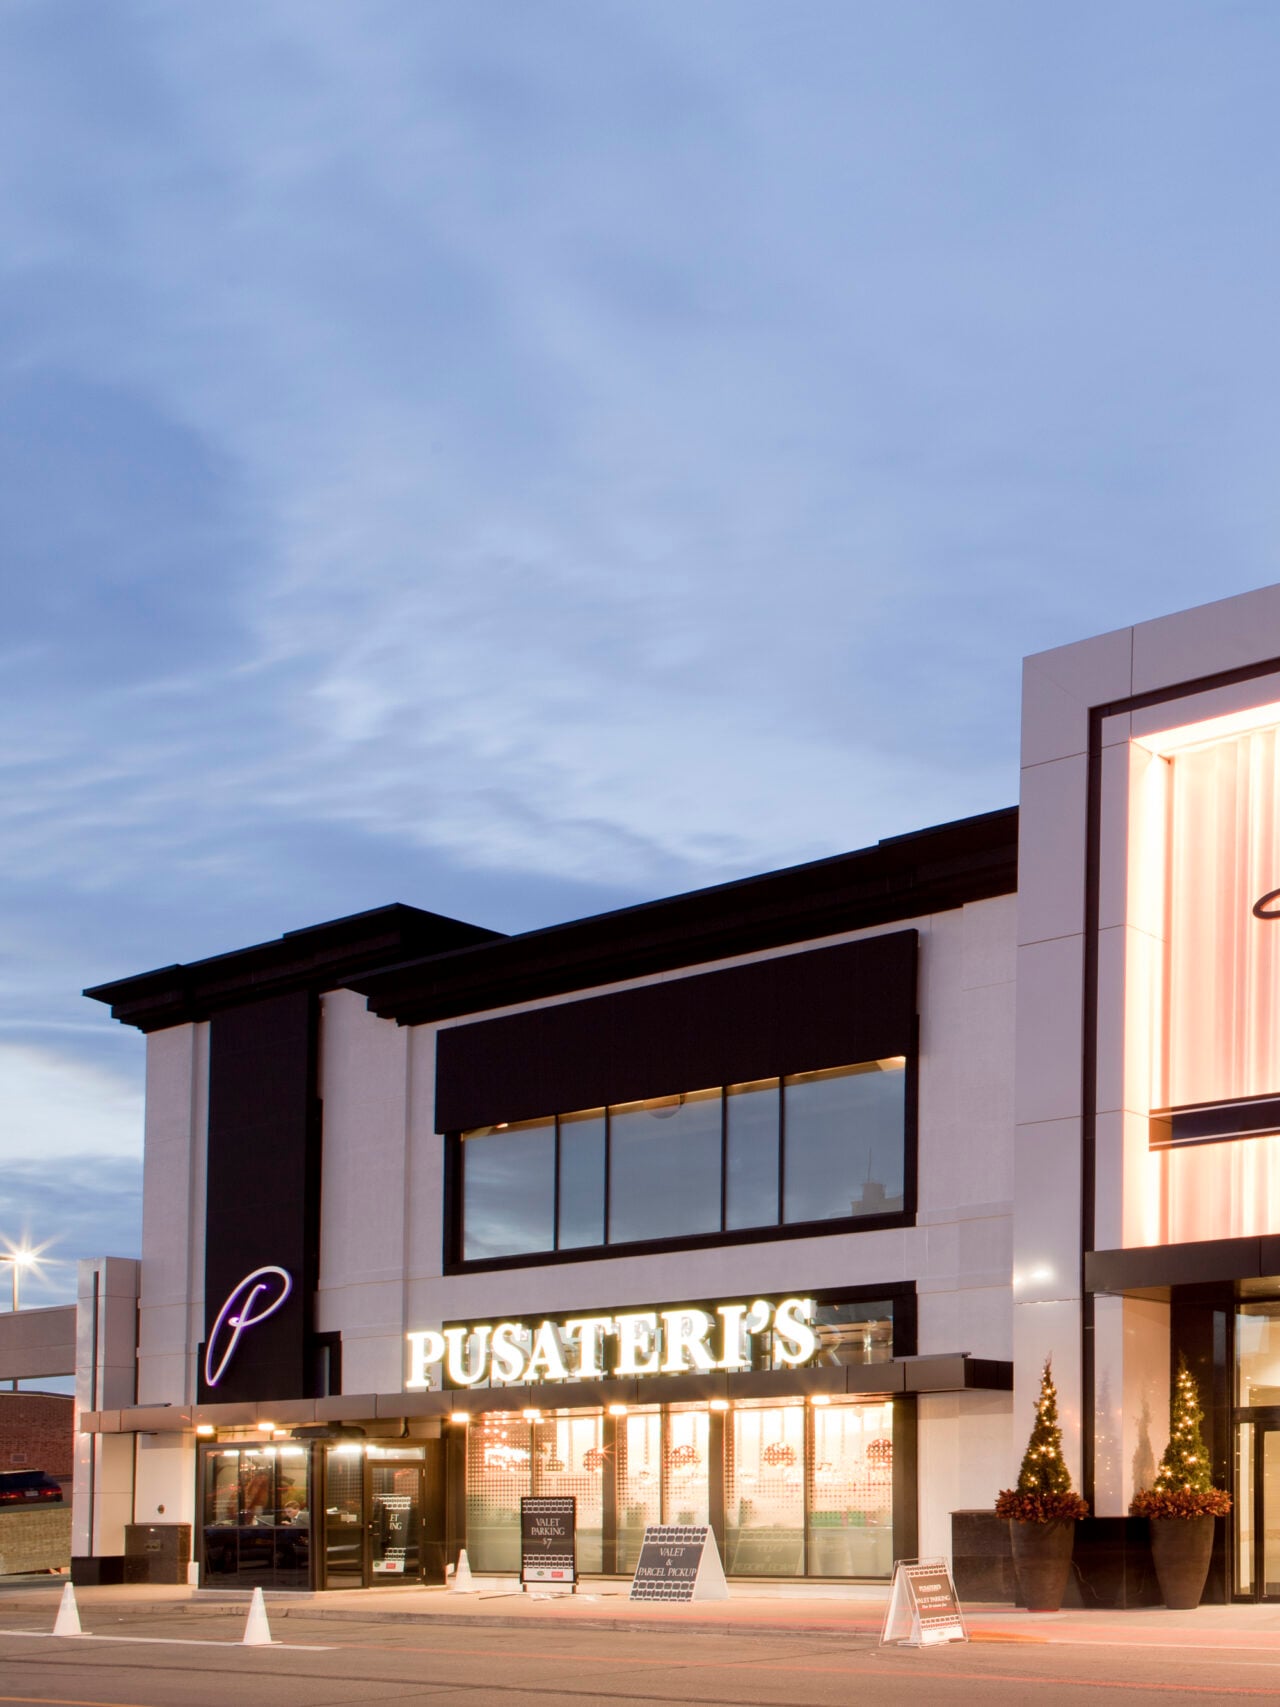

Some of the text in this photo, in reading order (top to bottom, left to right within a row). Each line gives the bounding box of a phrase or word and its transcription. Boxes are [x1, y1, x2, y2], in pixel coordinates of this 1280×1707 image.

[405, 1297, 821, 1389] PUSATERI'S
[535, 1518, 561, 1527] VALET
[531, 1527, 565, 1536] PARKING
[542, 1537, 552, 1549] $7
[659, 1547, 685, 1557] VALET
[665, 1558, 672, 1566] &
[638, 1567, 697, 1577] PARCEL PICKUP
